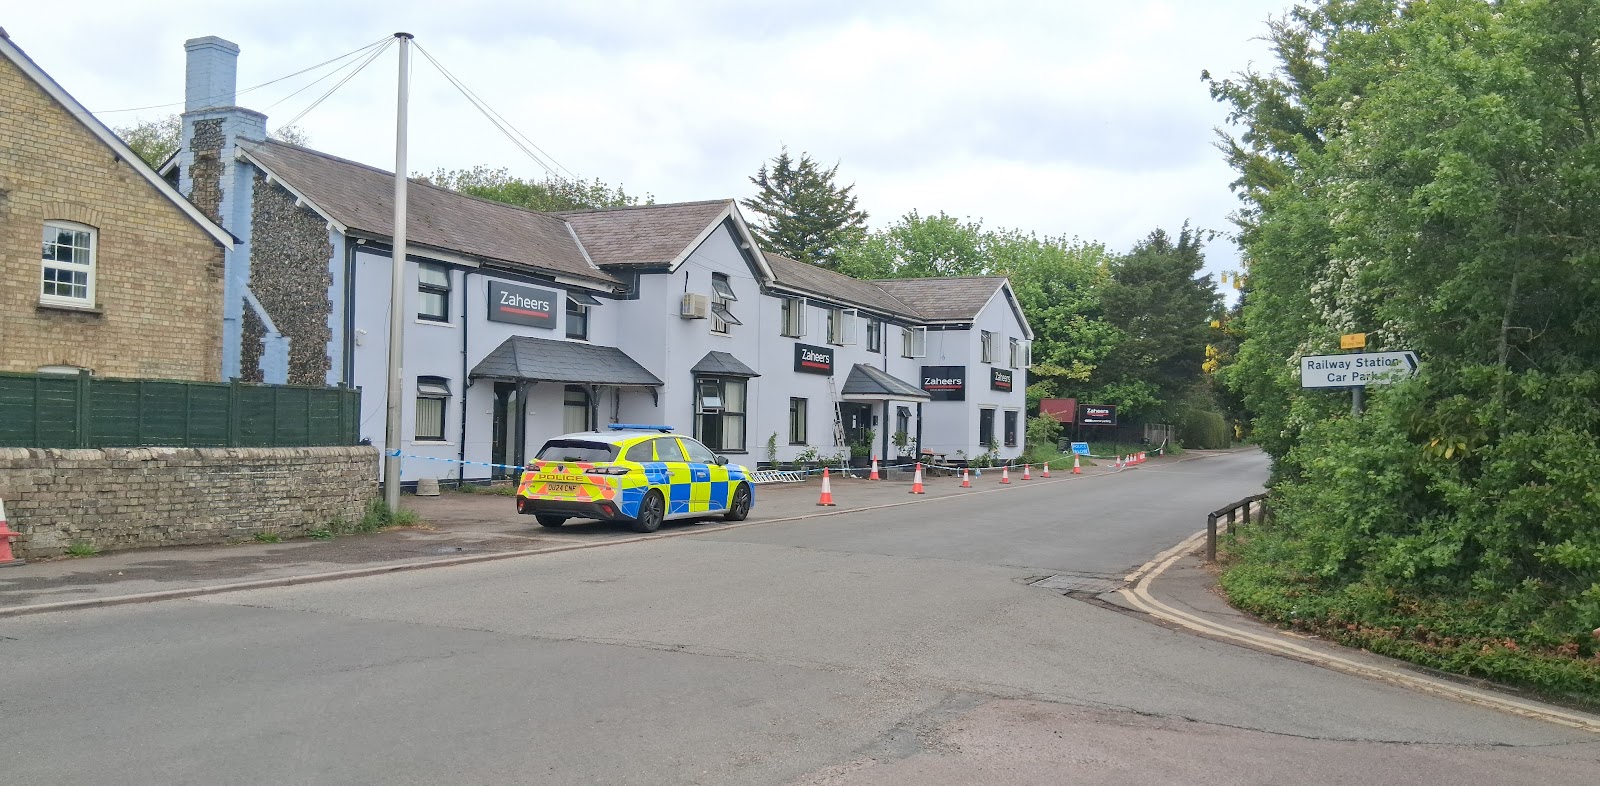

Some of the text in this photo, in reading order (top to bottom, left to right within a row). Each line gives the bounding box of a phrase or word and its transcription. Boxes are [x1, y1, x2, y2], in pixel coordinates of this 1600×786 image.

[500, 290, 550, 312] Zaheers
[801, 348, 830, 364] Zaheers
[1307, 357, 1399, 370] Railway Station
[924, 377, 962, 385] Zaheers
[995, 371, 1011, 383] Zaheers
[1327, 372, 1347, 383] Car
